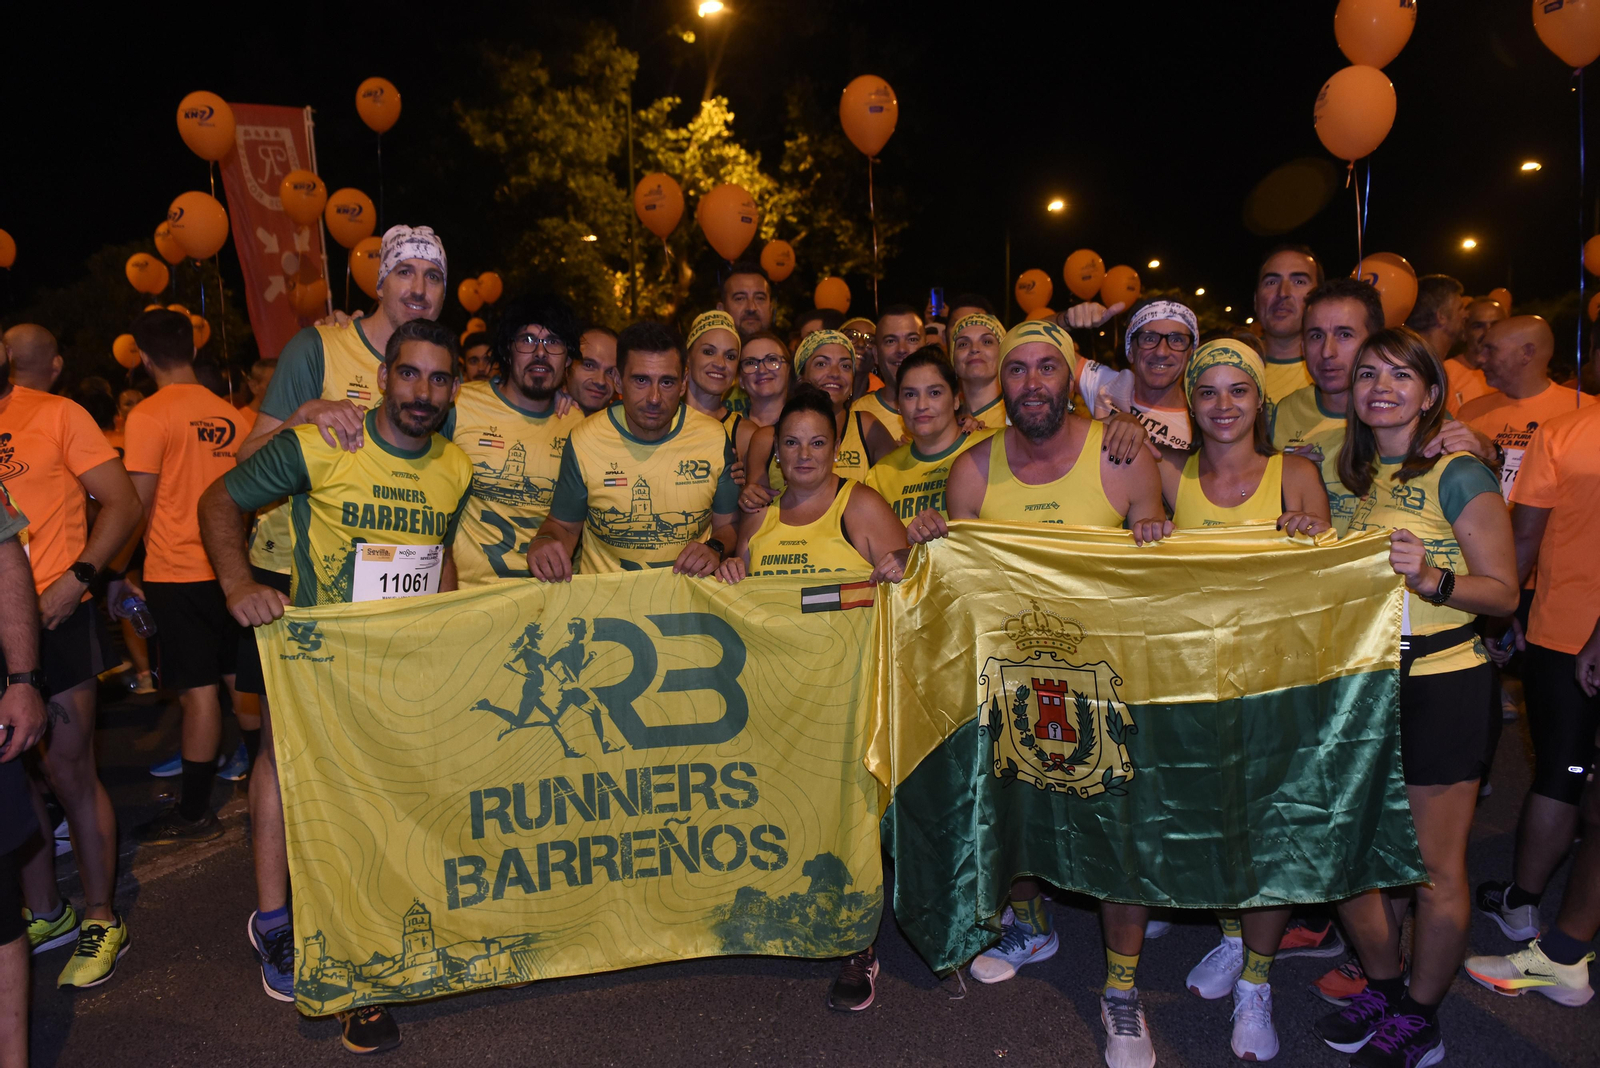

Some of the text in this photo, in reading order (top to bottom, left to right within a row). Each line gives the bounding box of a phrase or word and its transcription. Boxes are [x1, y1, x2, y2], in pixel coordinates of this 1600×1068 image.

[373, 485, 427, 504] RUNNERS
[760, 553, 808, 566] RUNNERS
[380, 573, 429, 593] 11061
[469, 762, 760, 840] RUNNERS
[444, 817, 789, 910] BARREÑOS
